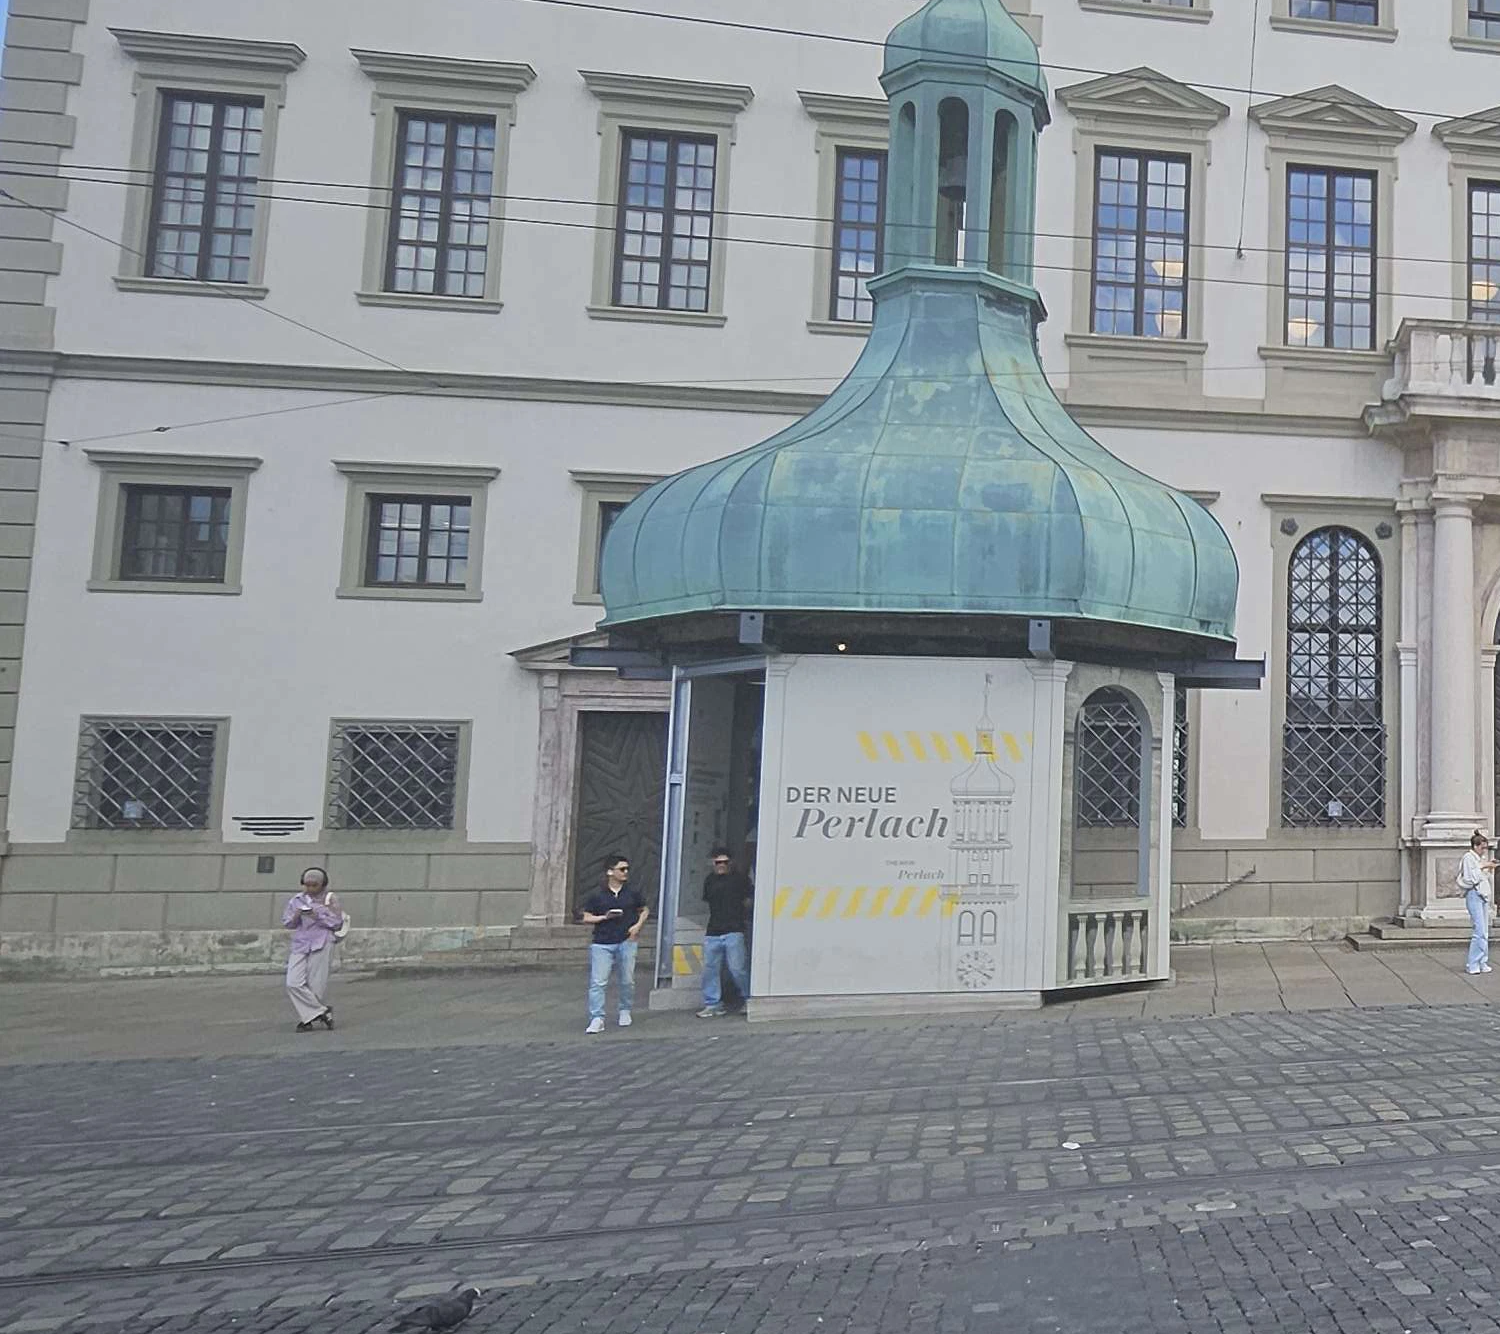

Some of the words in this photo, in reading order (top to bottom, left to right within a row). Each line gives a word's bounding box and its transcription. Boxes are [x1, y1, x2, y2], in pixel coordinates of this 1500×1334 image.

[786, 786, 832, 804] DER
[837, 786, 897, 804] NEUE
[793, 808, 949, 839] Perlach
[897, 869, 945, 880] Perlach
